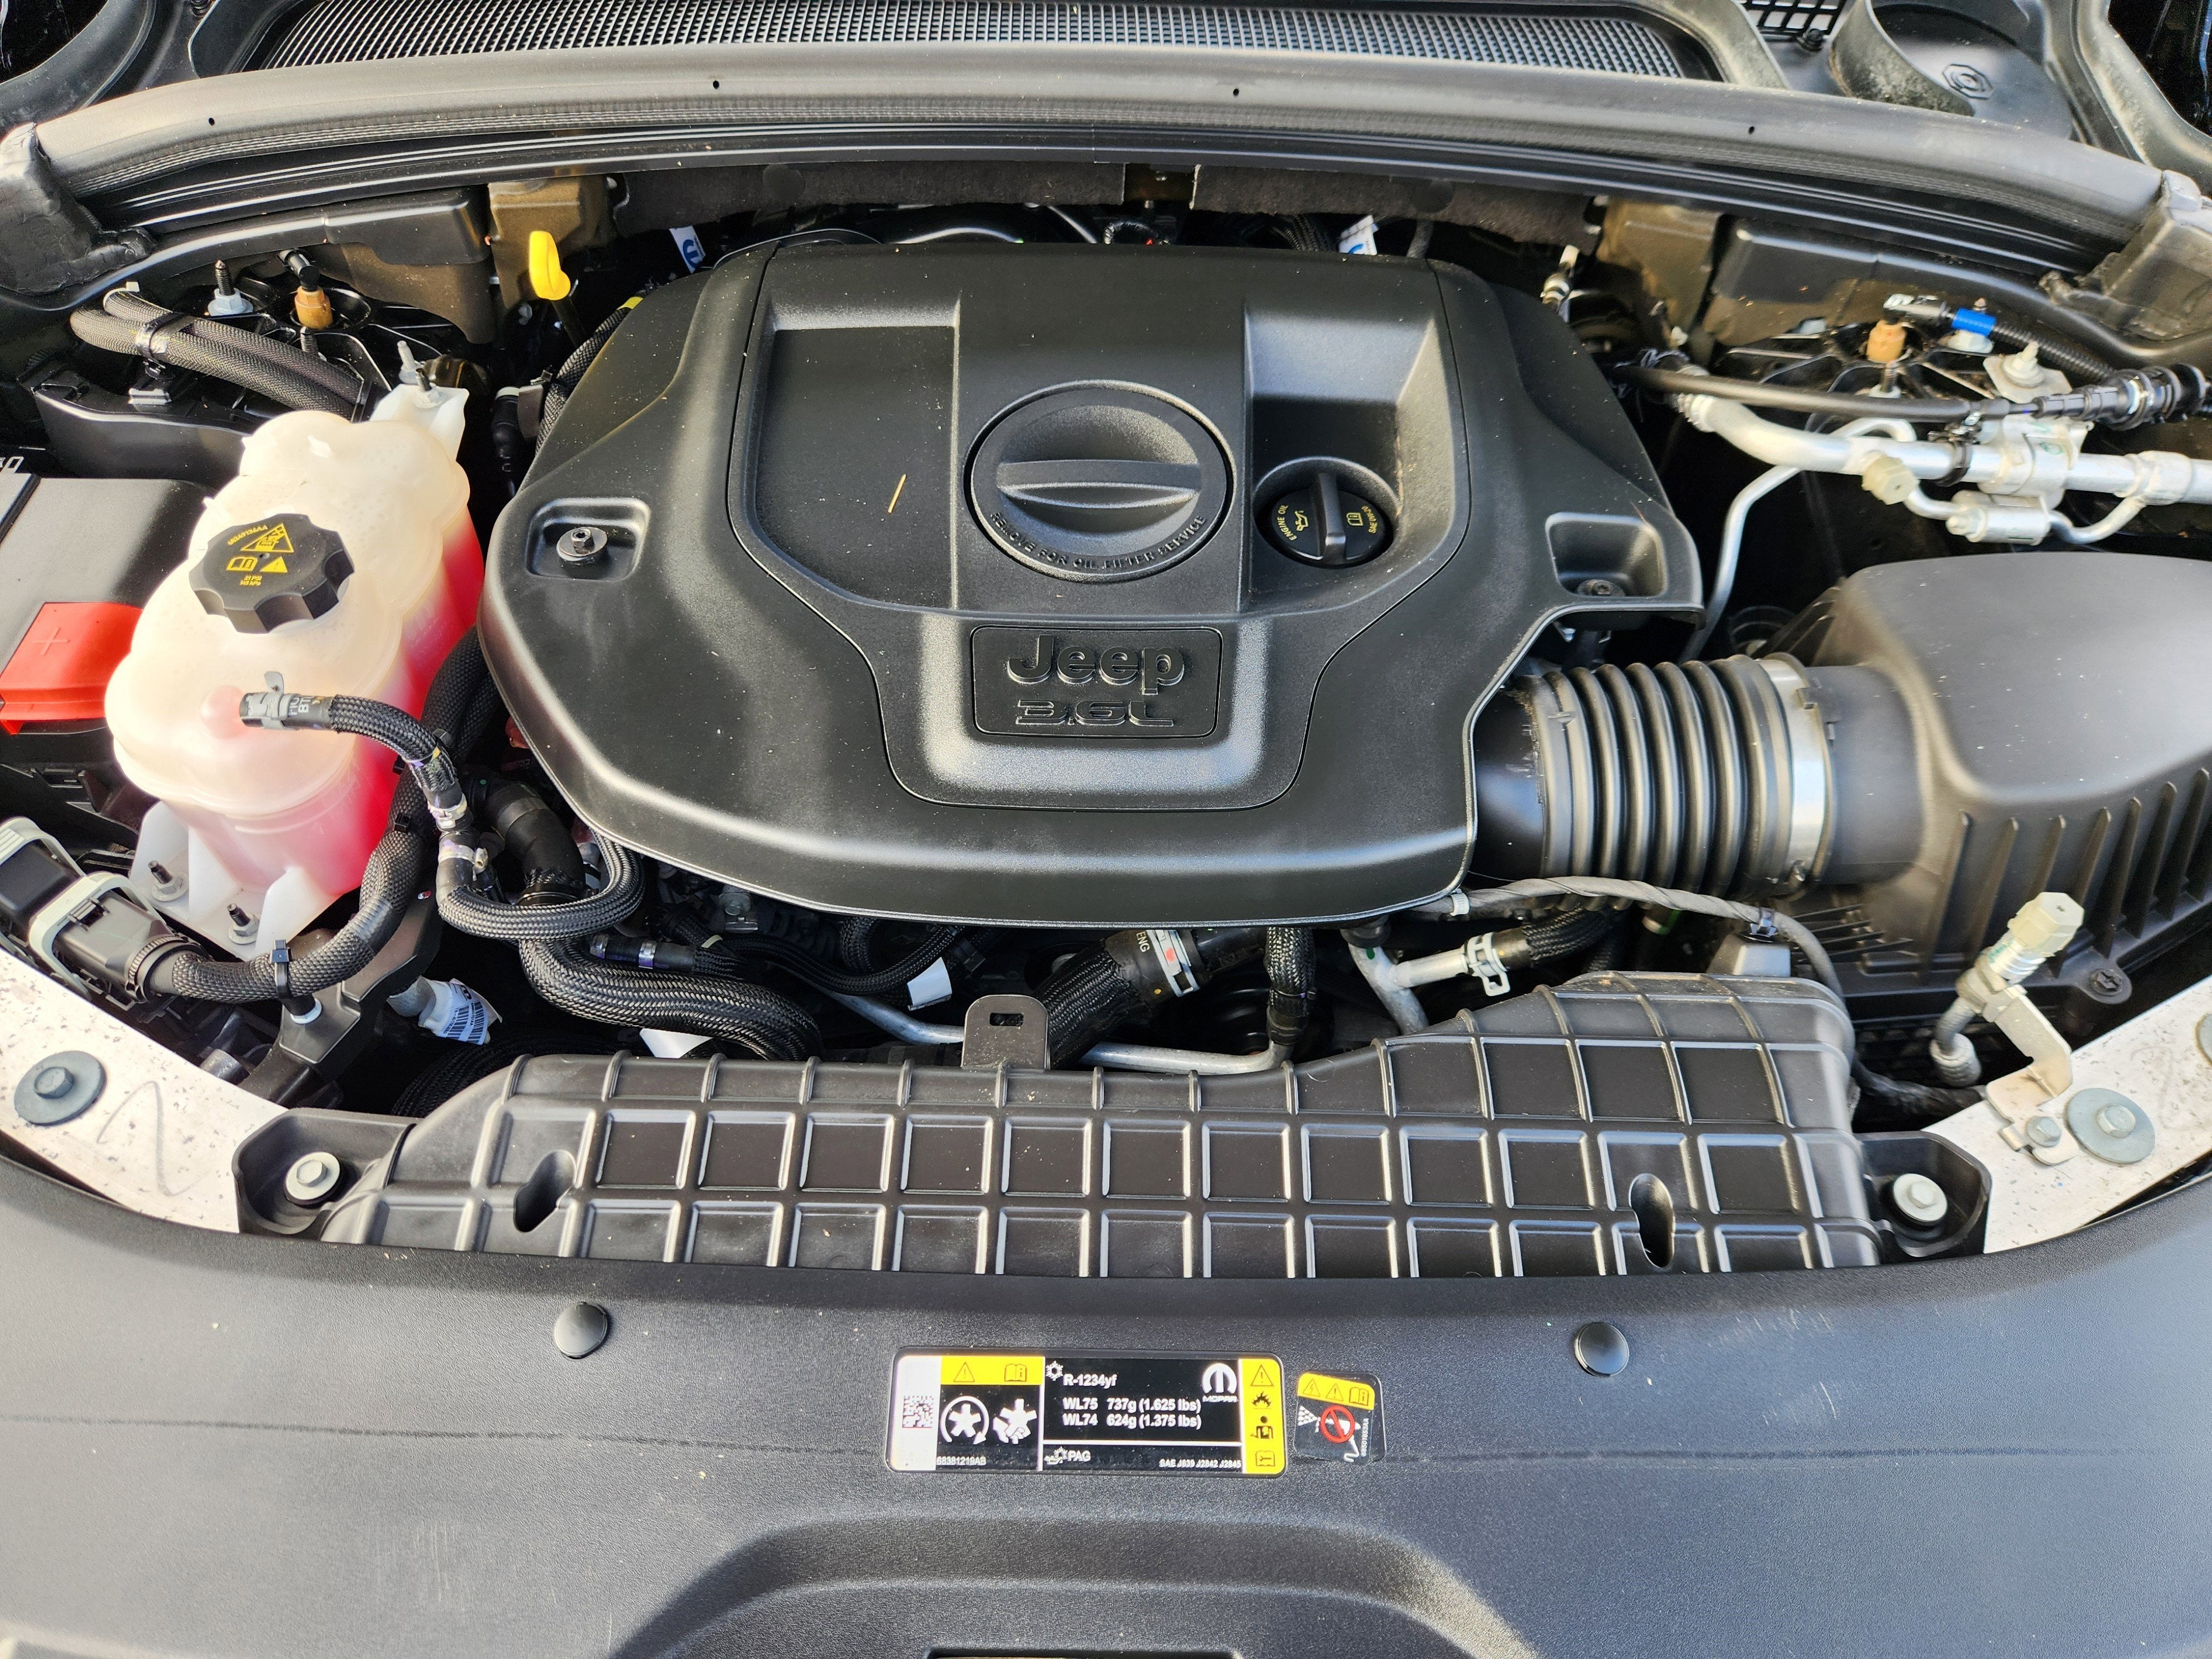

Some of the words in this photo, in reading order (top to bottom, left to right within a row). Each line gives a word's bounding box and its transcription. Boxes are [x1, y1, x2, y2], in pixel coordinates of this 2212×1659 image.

[1278, 505, 1288, 514] OIL
[1277, 517, 1297, 541] ENGINE
[1368, 522, 1378, 534] SAE
[990, 512, 1036, 552] REMOVE
[1038, 549, 1066, 565] FOR
[1073, 559, 1098, 569] OIL
[1104, 551, 1154, 569] FILTER
[1158, 515, 1206, 555] SERVICE
[1007, 634, 1185, 695] Jeep
[1015, 699, 1174, 727] 3.6L
[1136, 931, 1150, 953] ENG
[1062, 1374, 1117, 1389] R-1234yf
[1062, 1397, 1098, 1410] WL75
[1107, 1398, 1136, 1412] 737g
[1139, 1398, 1176, 1413] (1.625
[1178, 1398, 1202, 1413] lbs)
[1062, 1413, 1098, 1426] WL74
[1106, 1414, 1136, 1429] 624g
[1139, 1414, 1176, 1430] (1.375
[1178, 1414, 1202, 1430] lbs)
[1067, 1450, 1091, 1462] PAG
[1159, 1459, 1176, 1468] SAE
